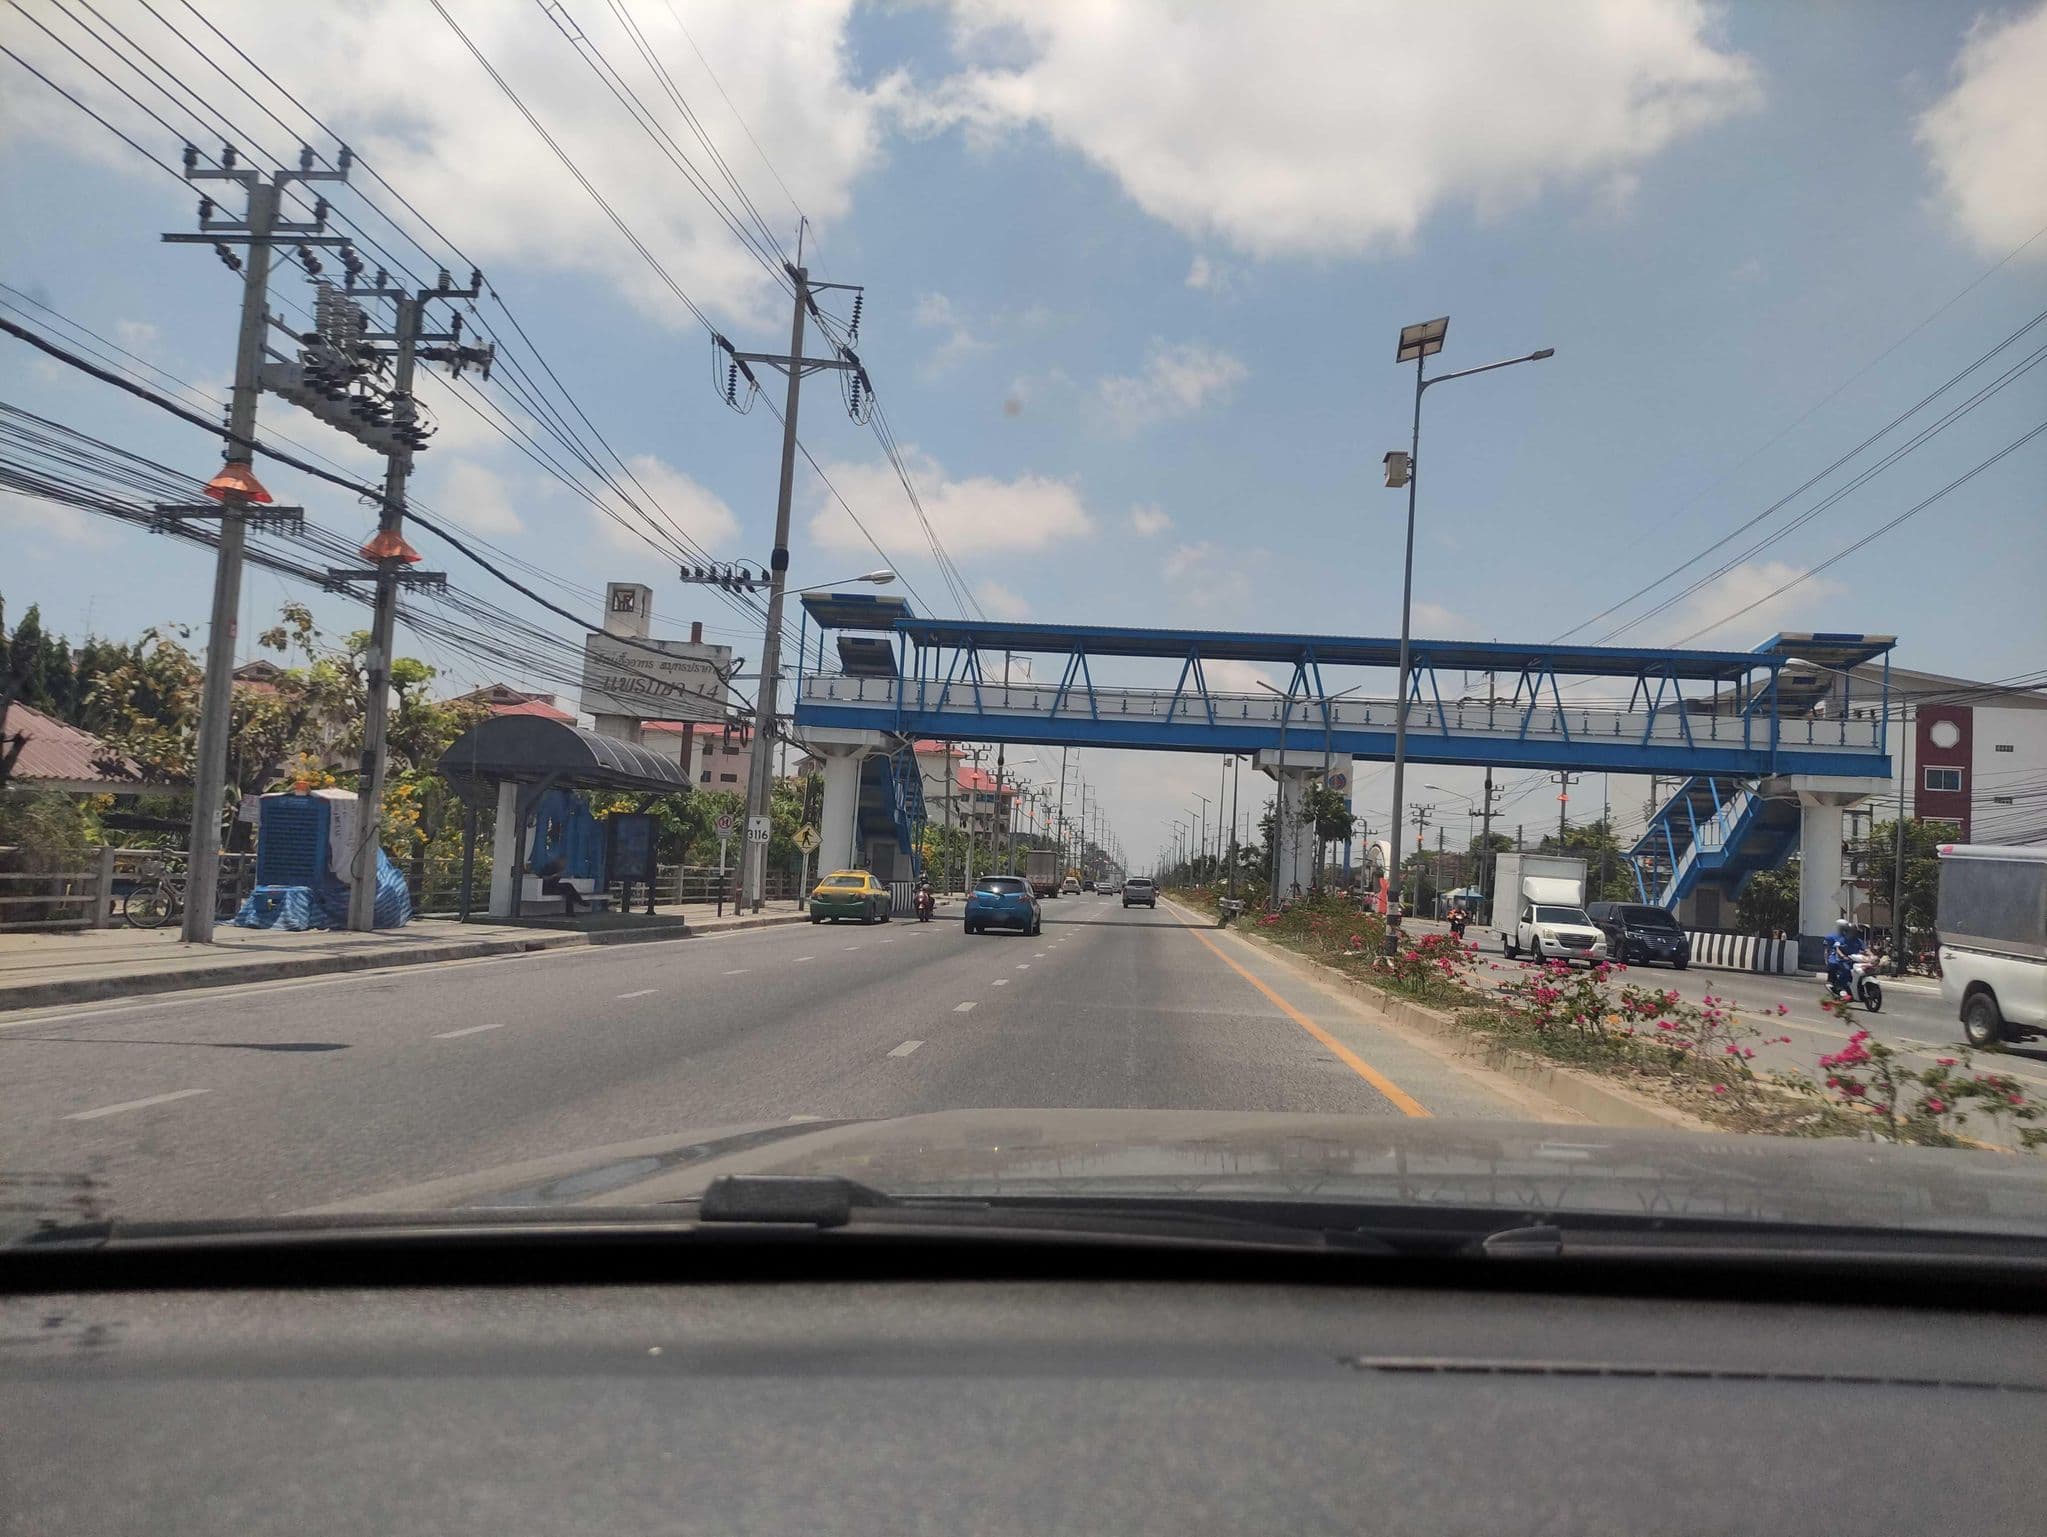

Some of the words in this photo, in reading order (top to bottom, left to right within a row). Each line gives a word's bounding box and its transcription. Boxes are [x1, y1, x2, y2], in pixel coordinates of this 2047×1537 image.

[659, 661, 720, 675] สมุทรปราก
[695, 683, 721, 698] 14
[747, 829, 769, 840] 3116
